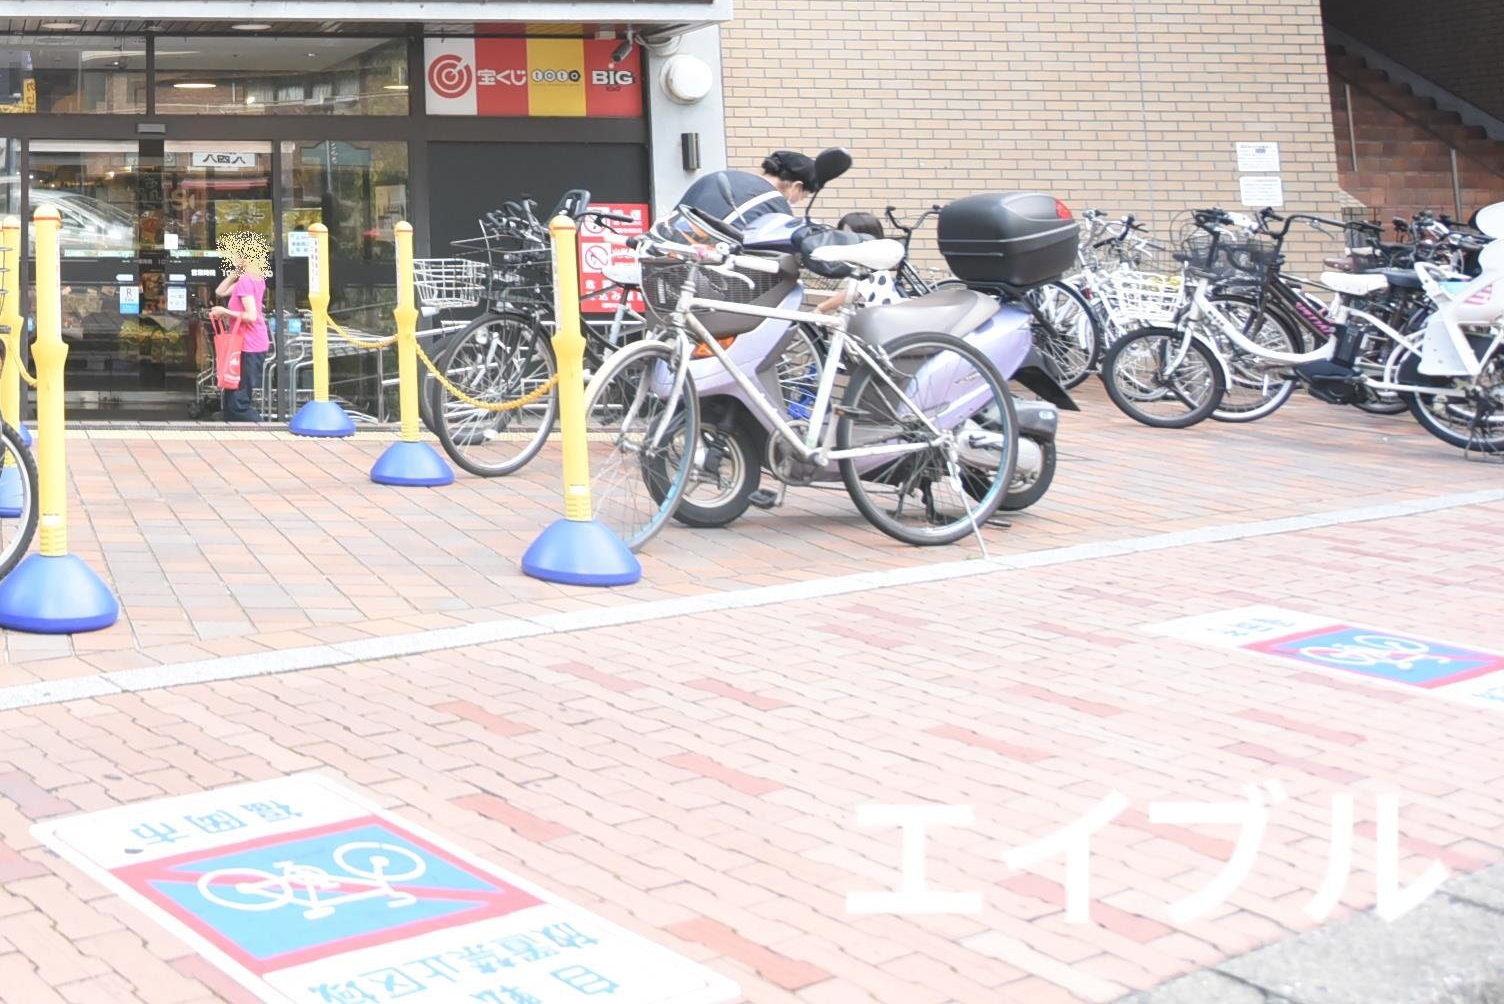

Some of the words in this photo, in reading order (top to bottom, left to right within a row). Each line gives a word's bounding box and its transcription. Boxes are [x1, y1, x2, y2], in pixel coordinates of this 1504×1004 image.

[477, 69, 527, 86] 宝くじ
[532, 69, 581, 83] toto
